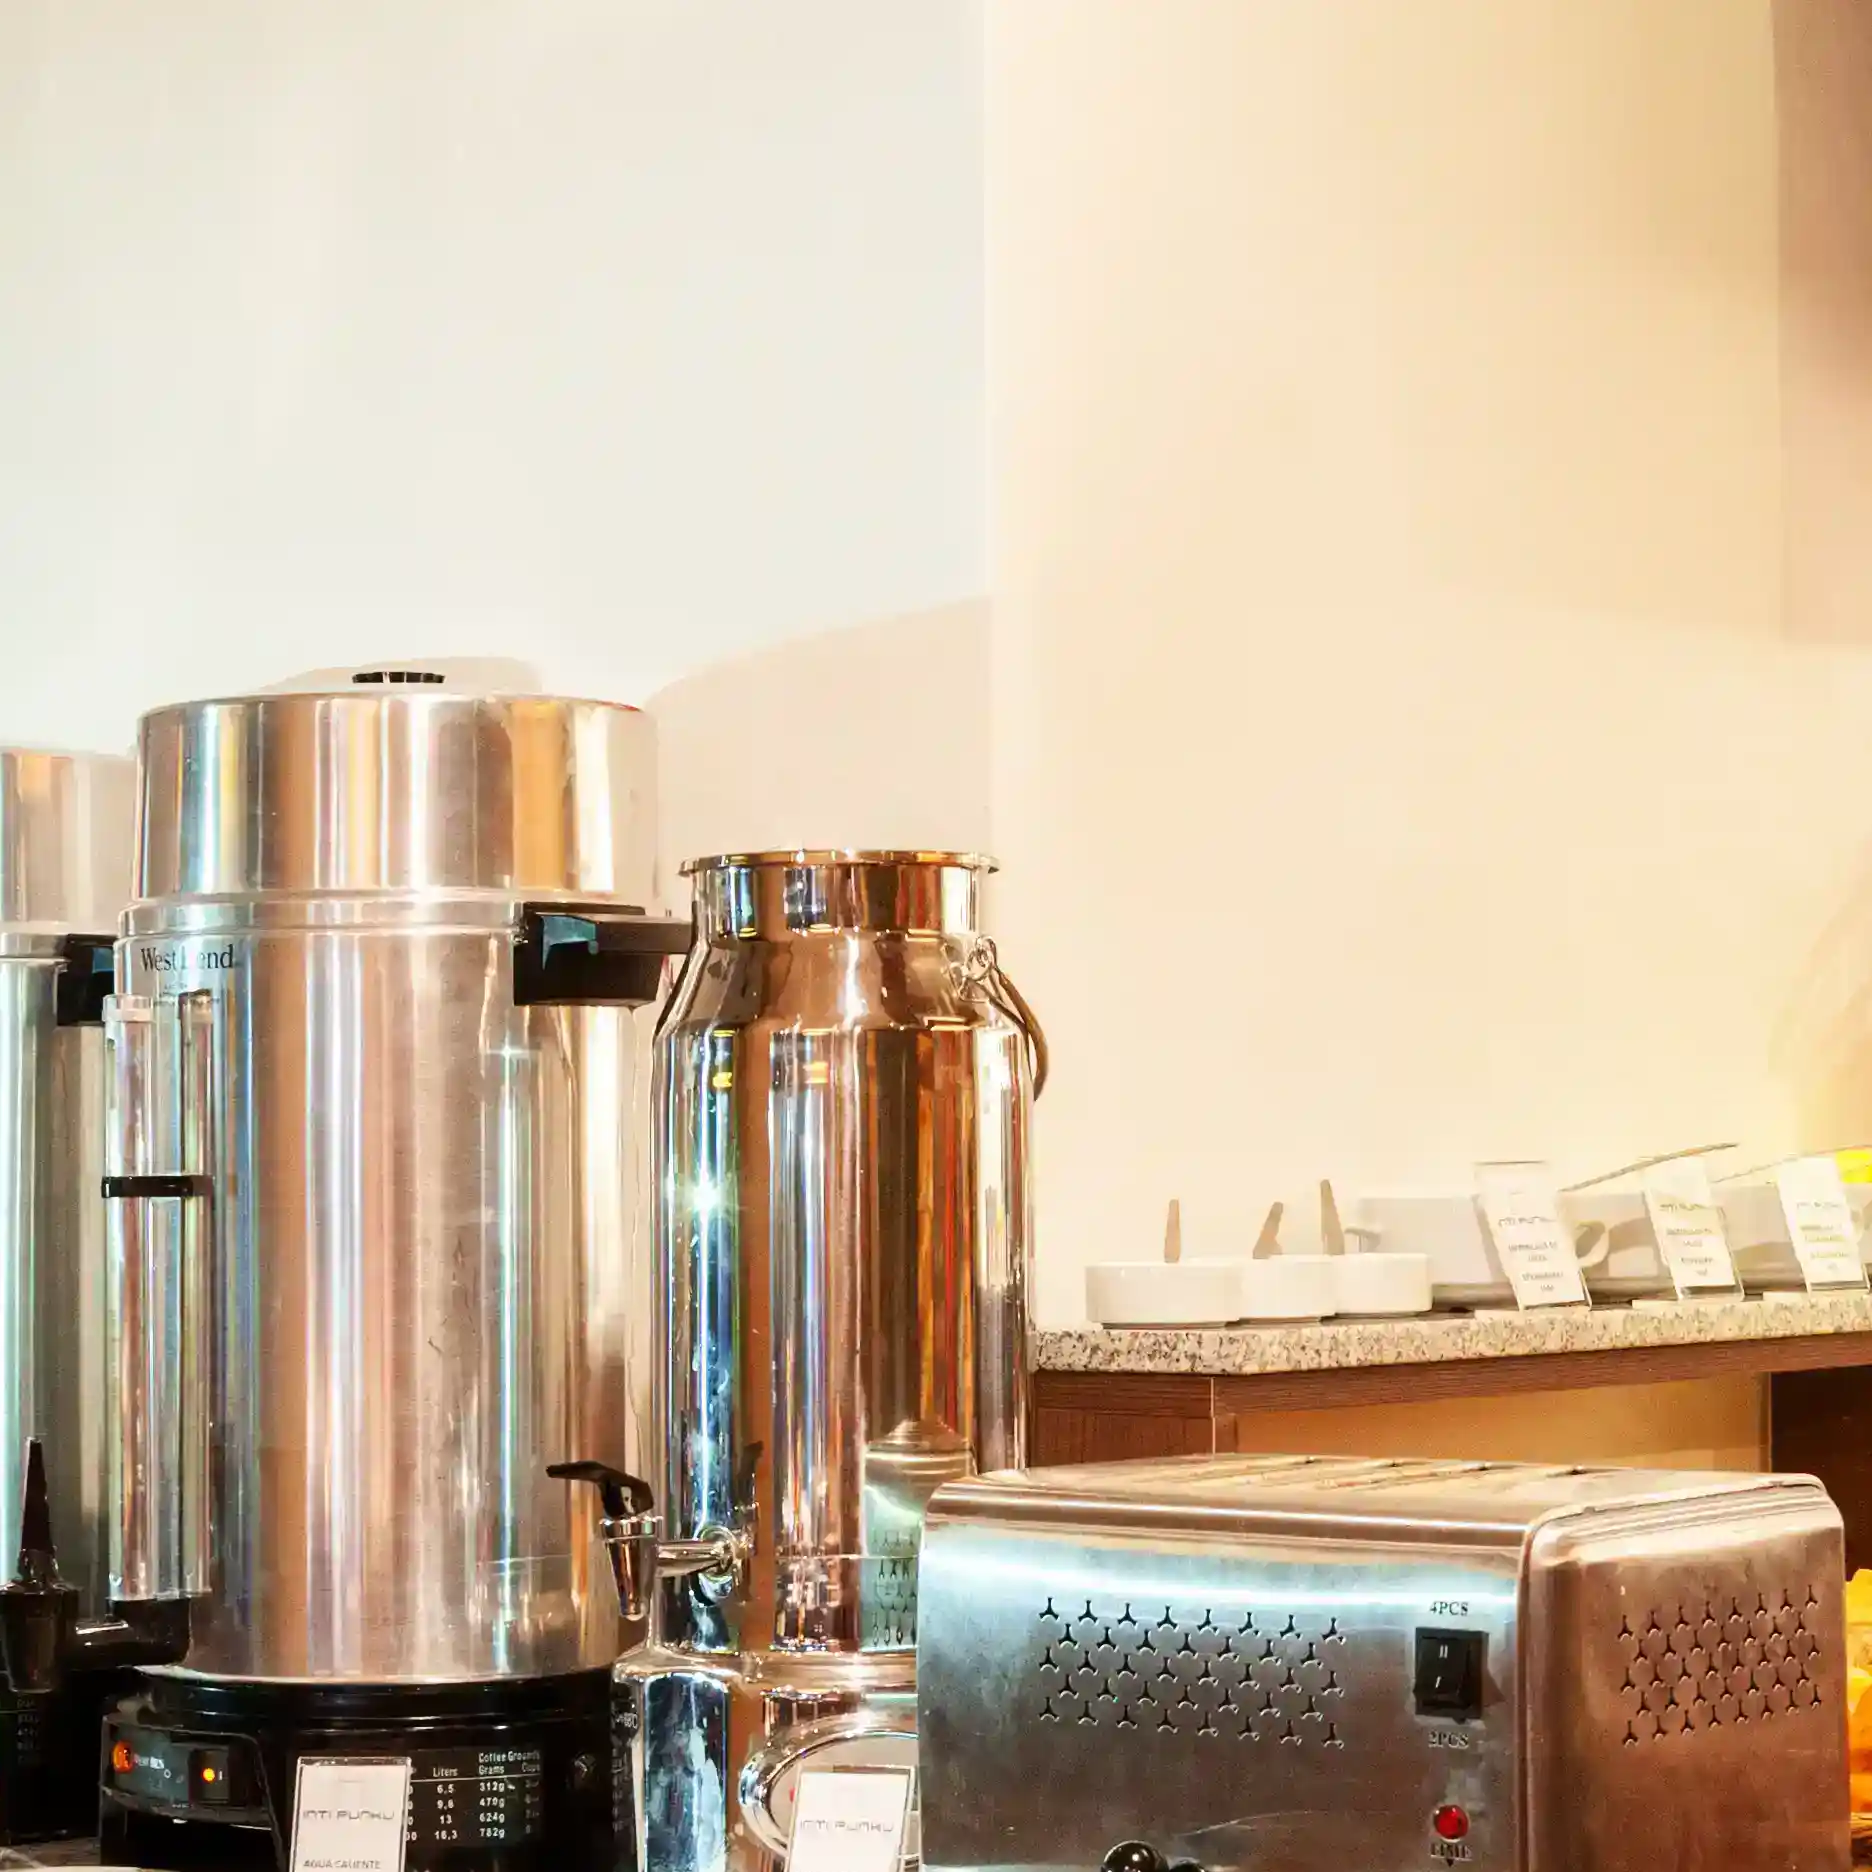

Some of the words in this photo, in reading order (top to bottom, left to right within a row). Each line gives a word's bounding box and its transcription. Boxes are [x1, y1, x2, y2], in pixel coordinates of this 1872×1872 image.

[140, 947, 178, 971] West
[1429, 1601, 1469, 1616] 4PCS
[1428, 1731, 1469, 1748] 2PCS
[432, 1767, 458, 1777] Liters
[436, 1784, 455, 1795] 6.5
